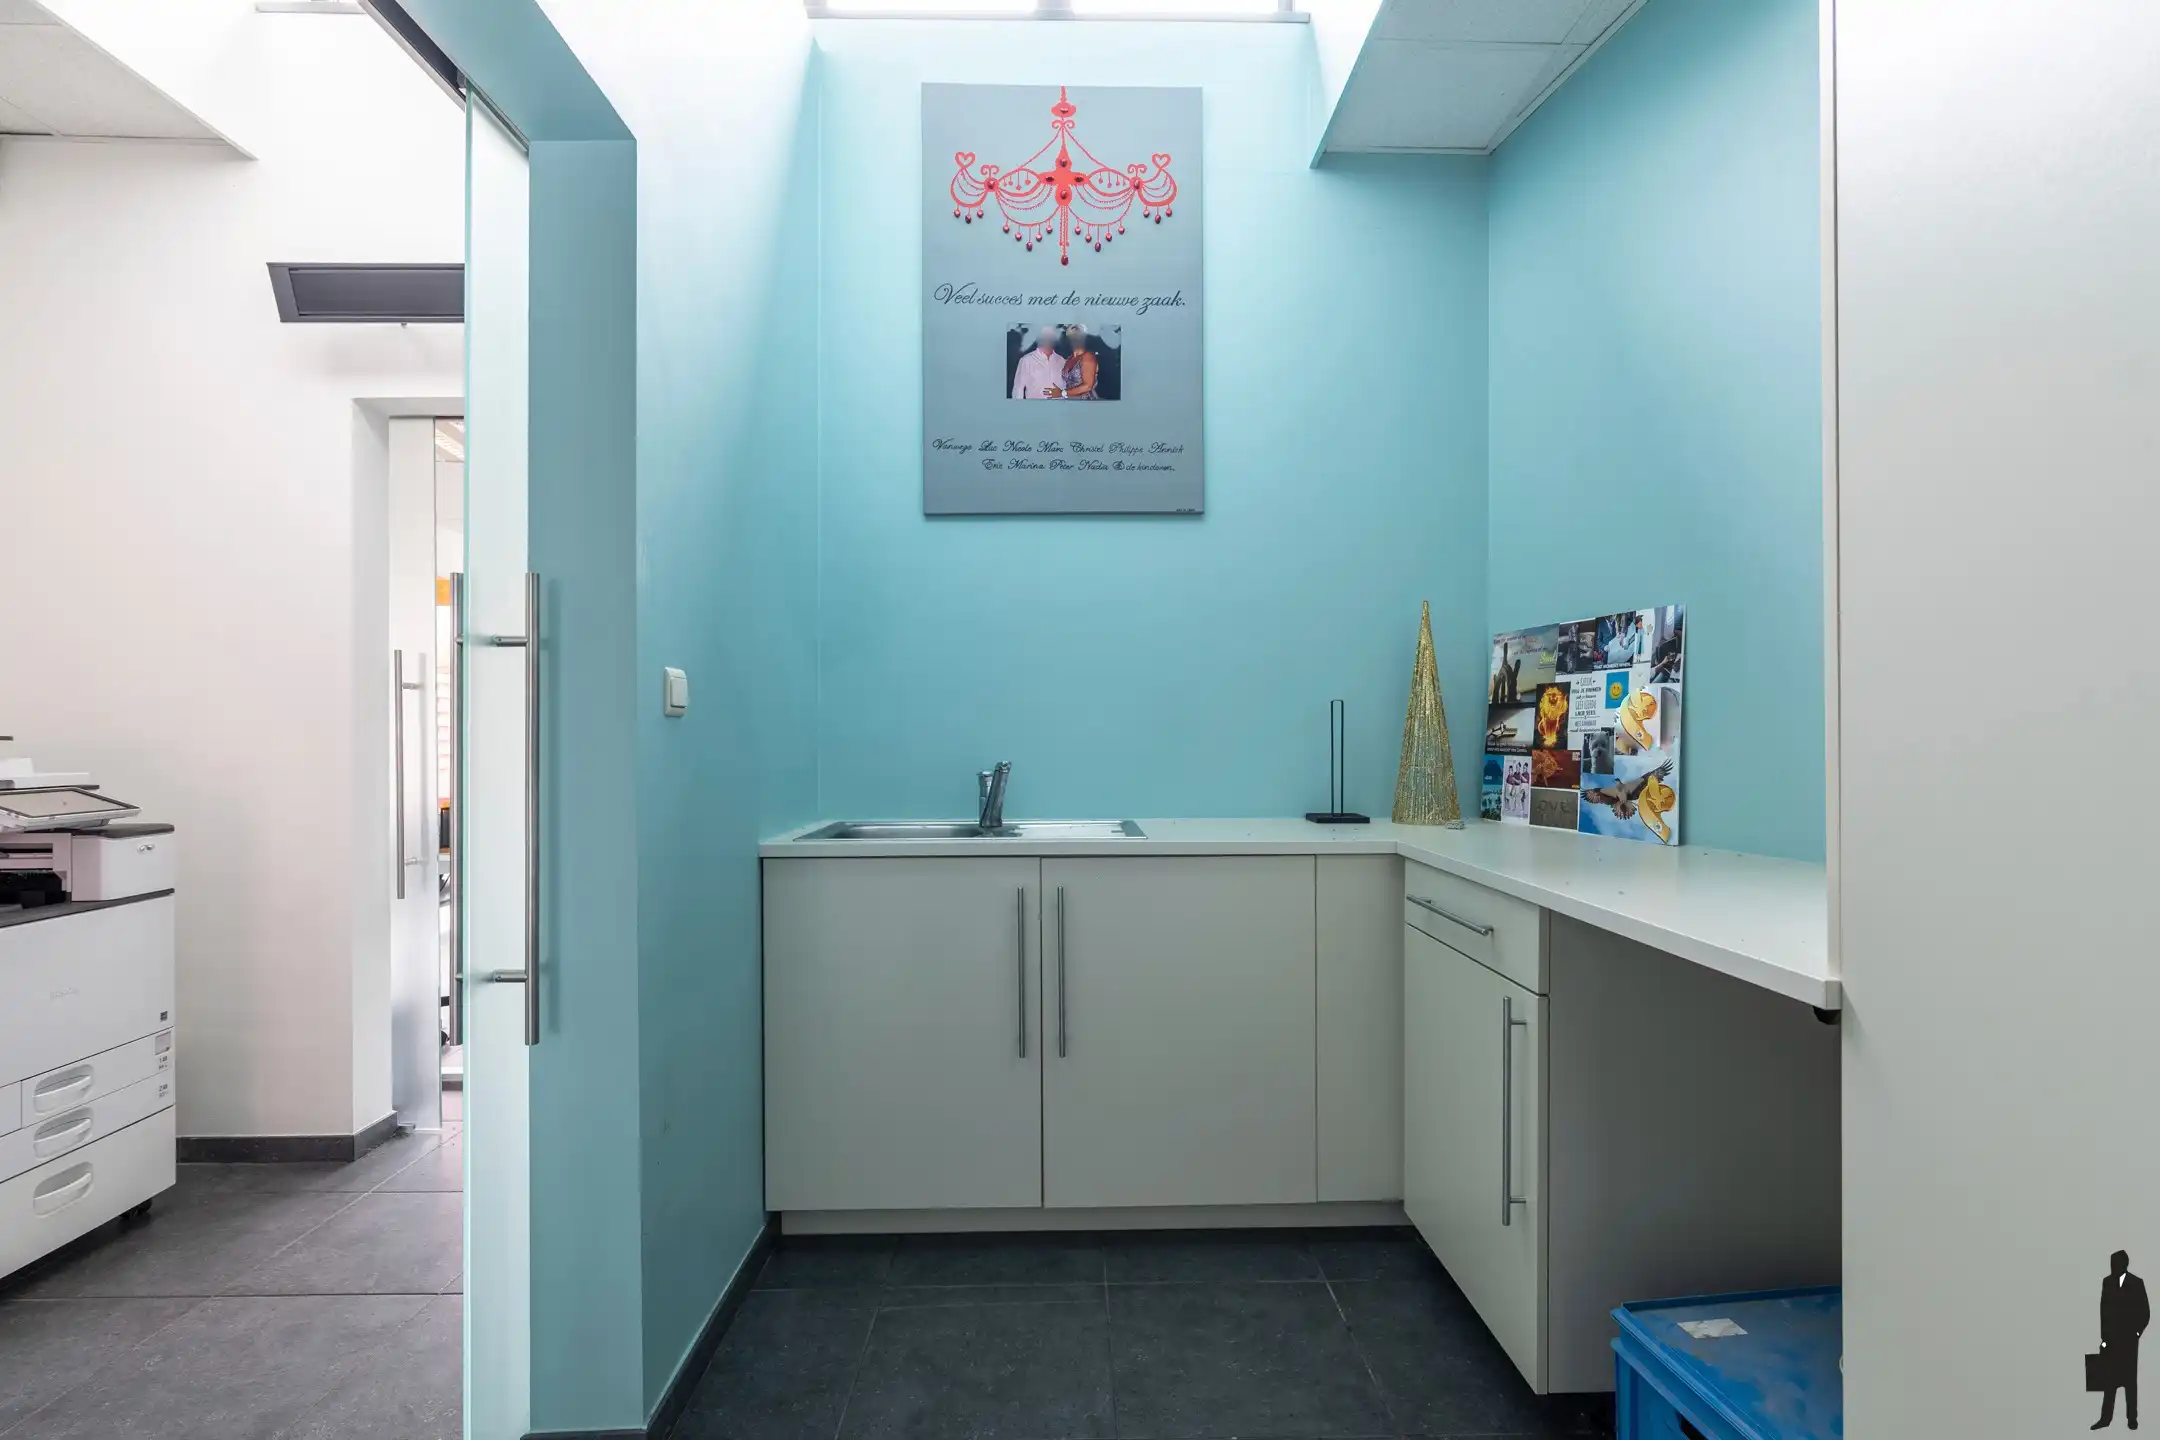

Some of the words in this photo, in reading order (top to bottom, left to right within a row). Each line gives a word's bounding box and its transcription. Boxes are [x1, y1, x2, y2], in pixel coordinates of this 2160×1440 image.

[933, 282, 979, 305] Veel
[977, 293, 1023, 306] succes
[1028, 292, 1058, 306] met
[1061, 290, 1081, 306] de
[1084, 293, 1140, 306] nieuwe
[1136, 290, 1186, 316] zaak.
